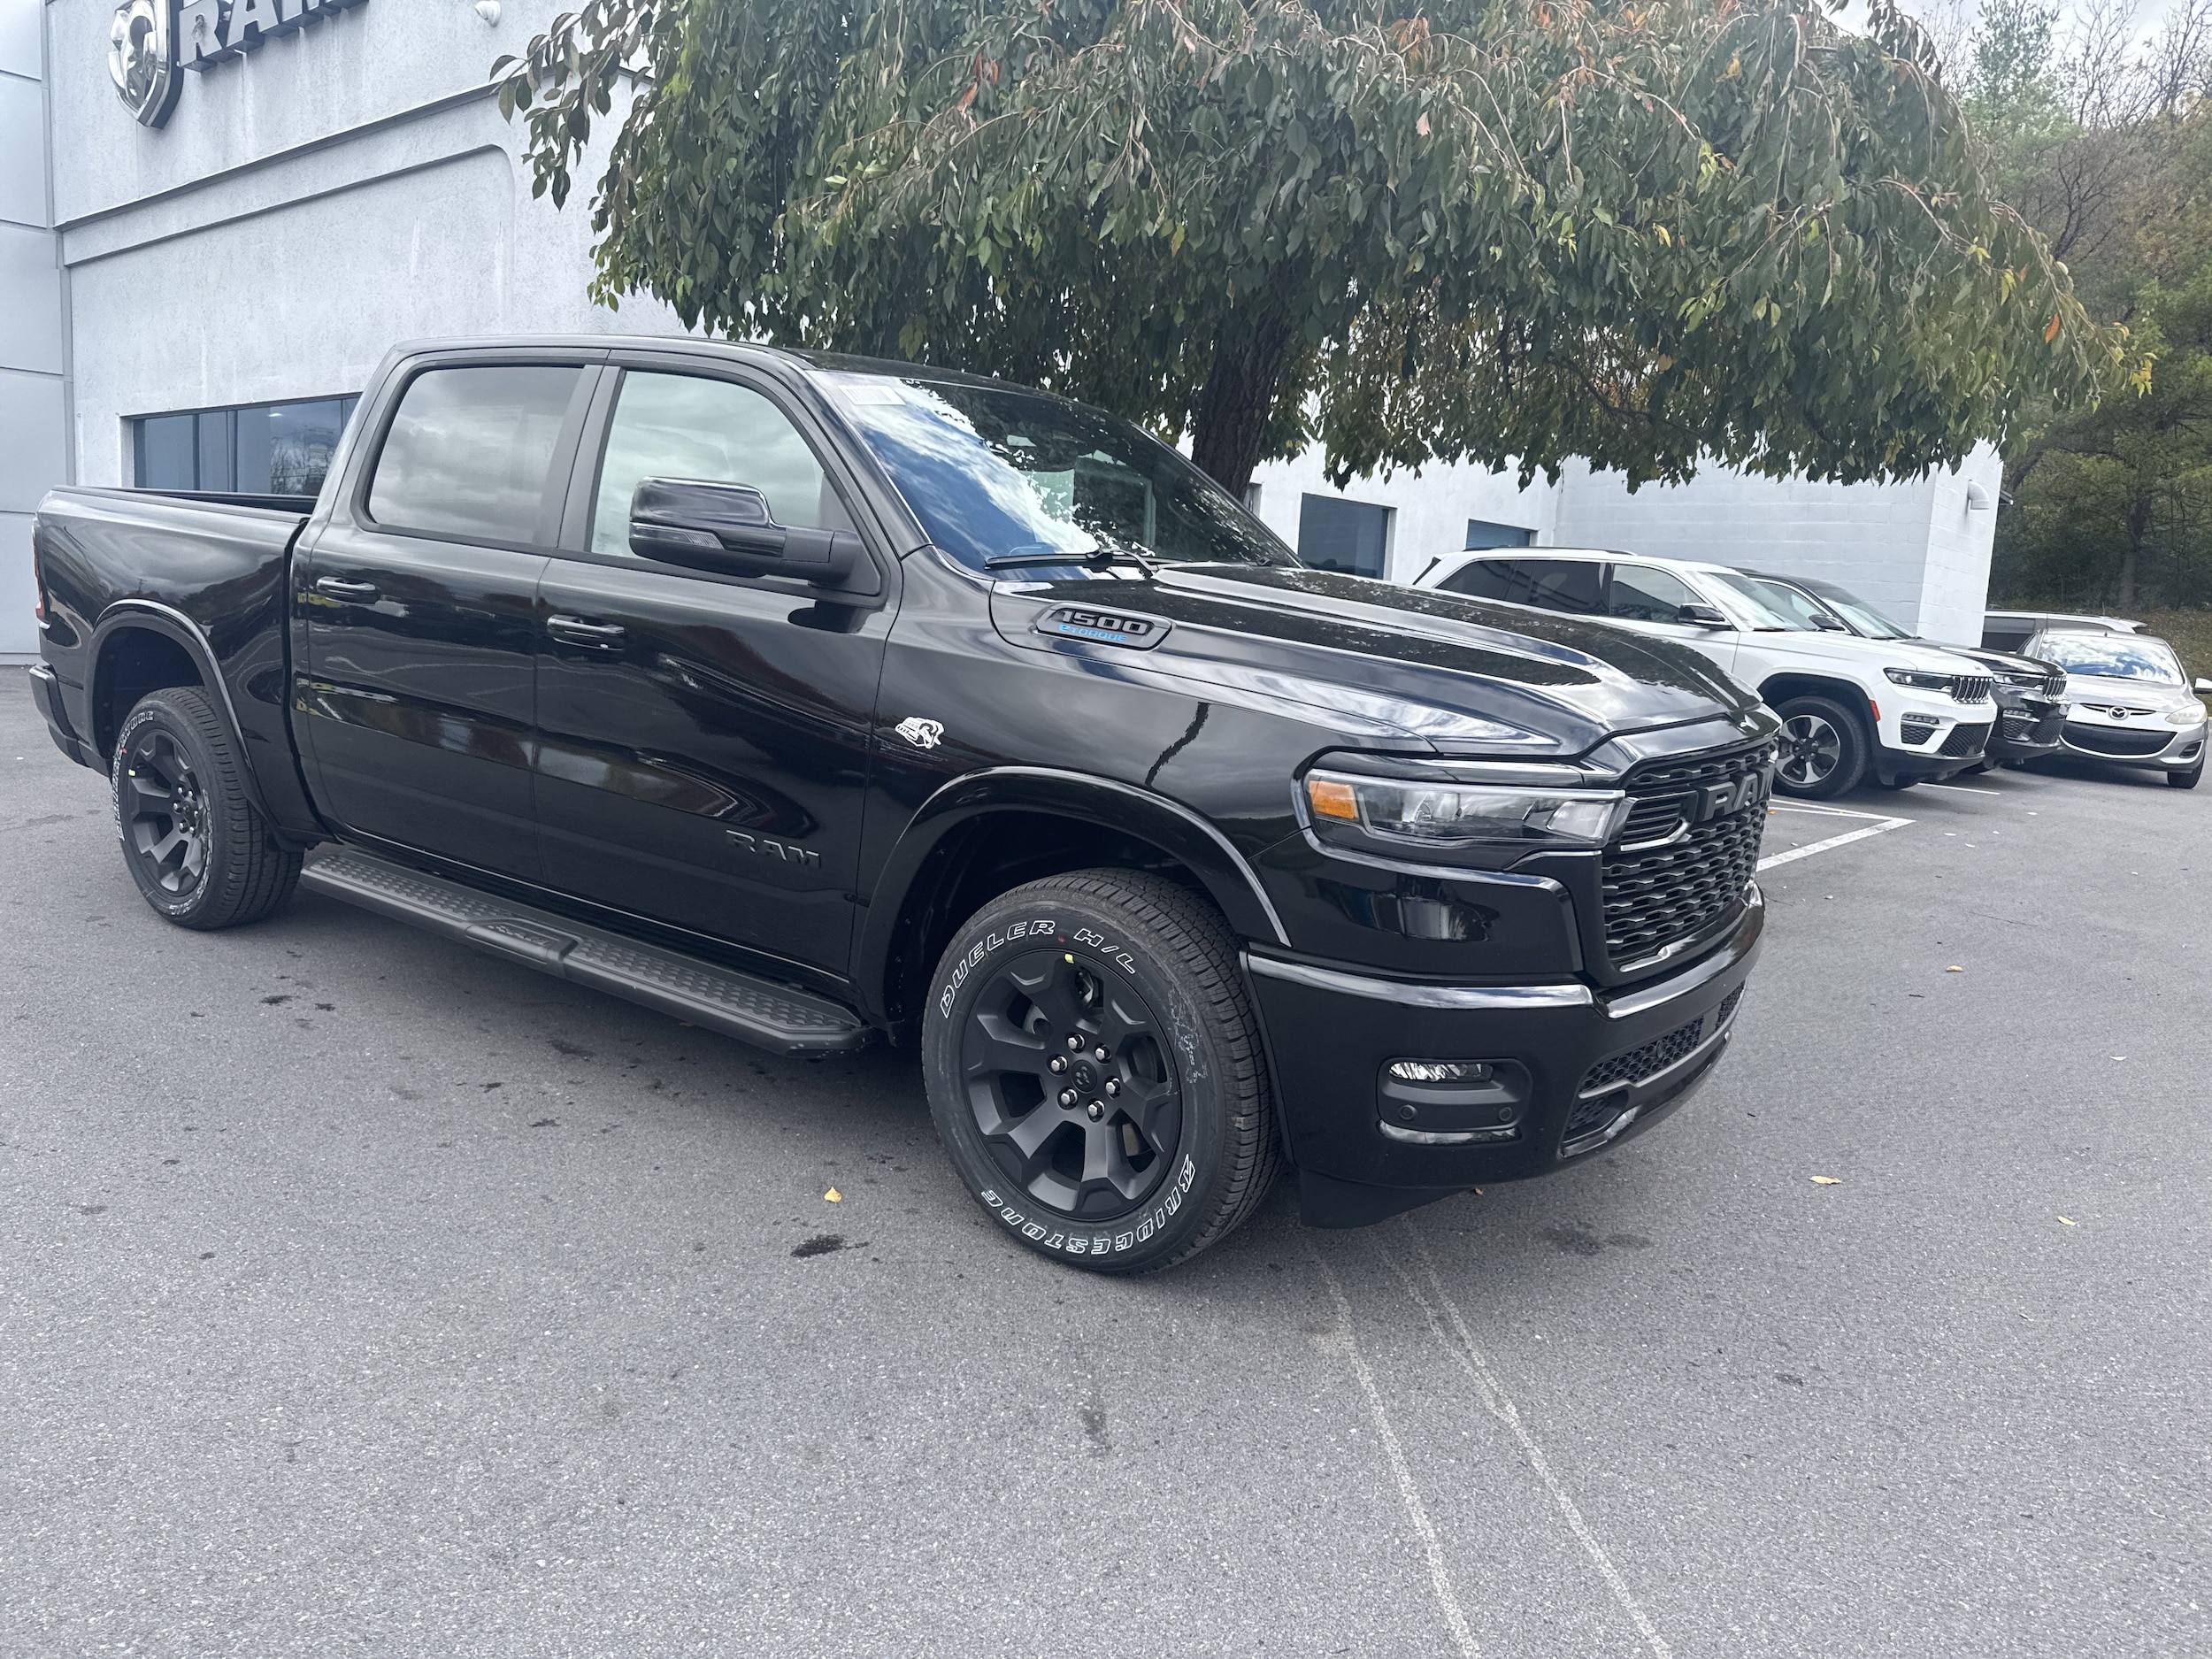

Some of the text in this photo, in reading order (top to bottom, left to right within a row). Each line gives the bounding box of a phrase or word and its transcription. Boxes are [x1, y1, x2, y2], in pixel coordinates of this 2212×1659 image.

[1061, 609, 1149, 635] 1500
[726, 829, 822, 868] RAM
[940, 919, 1136, 1018] DUELER H/L
[980, 1153, 1196, 1256] BRIDGESTONE
